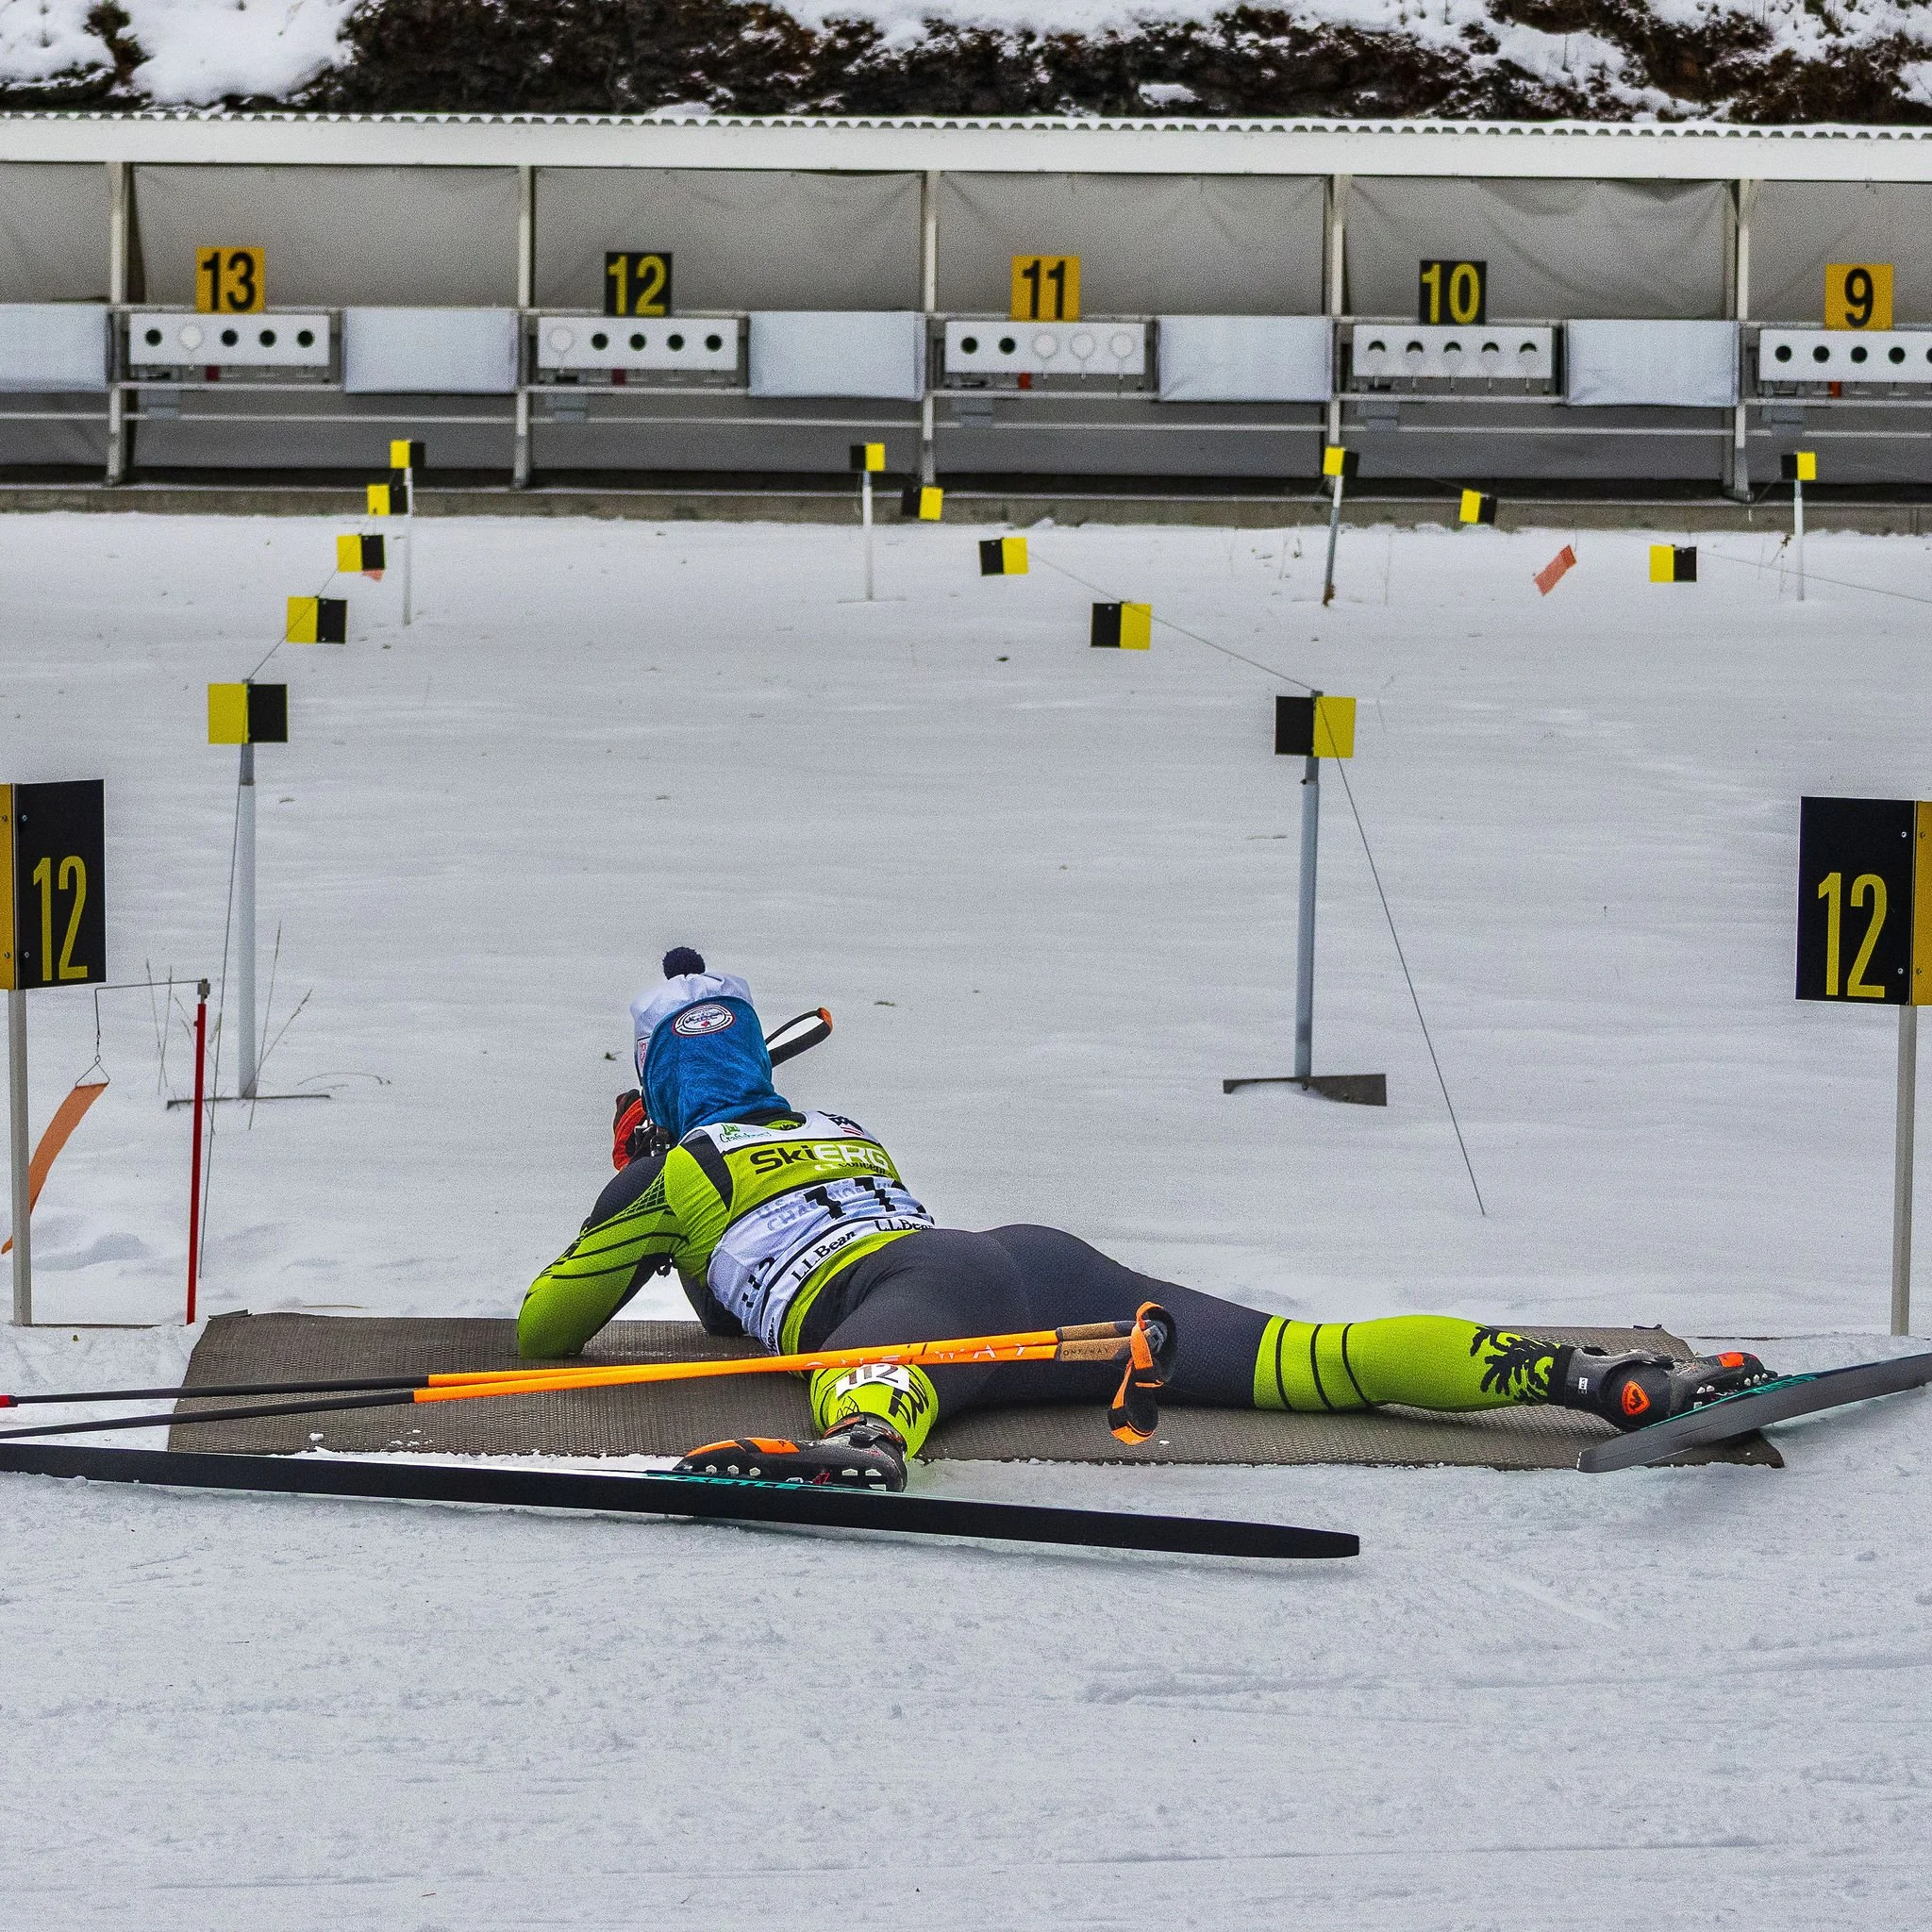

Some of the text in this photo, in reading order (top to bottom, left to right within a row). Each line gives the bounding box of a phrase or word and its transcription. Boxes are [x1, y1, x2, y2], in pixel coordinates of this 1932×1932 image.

[203, 251, 256, 312] 13
[607, 254, 666, 317] 12
[1022, 258, 1066, 320] 11
[1421, 262, 1480, 325] 10
[1843, 268, 1874, 328] 9
[33, 855, 89, 982] 12
[1818, 872, 1888, 999] 12
[750, 1143, 890, 1175] SkiERG
[791, 1230, 857, 1282] L.L.Bean
